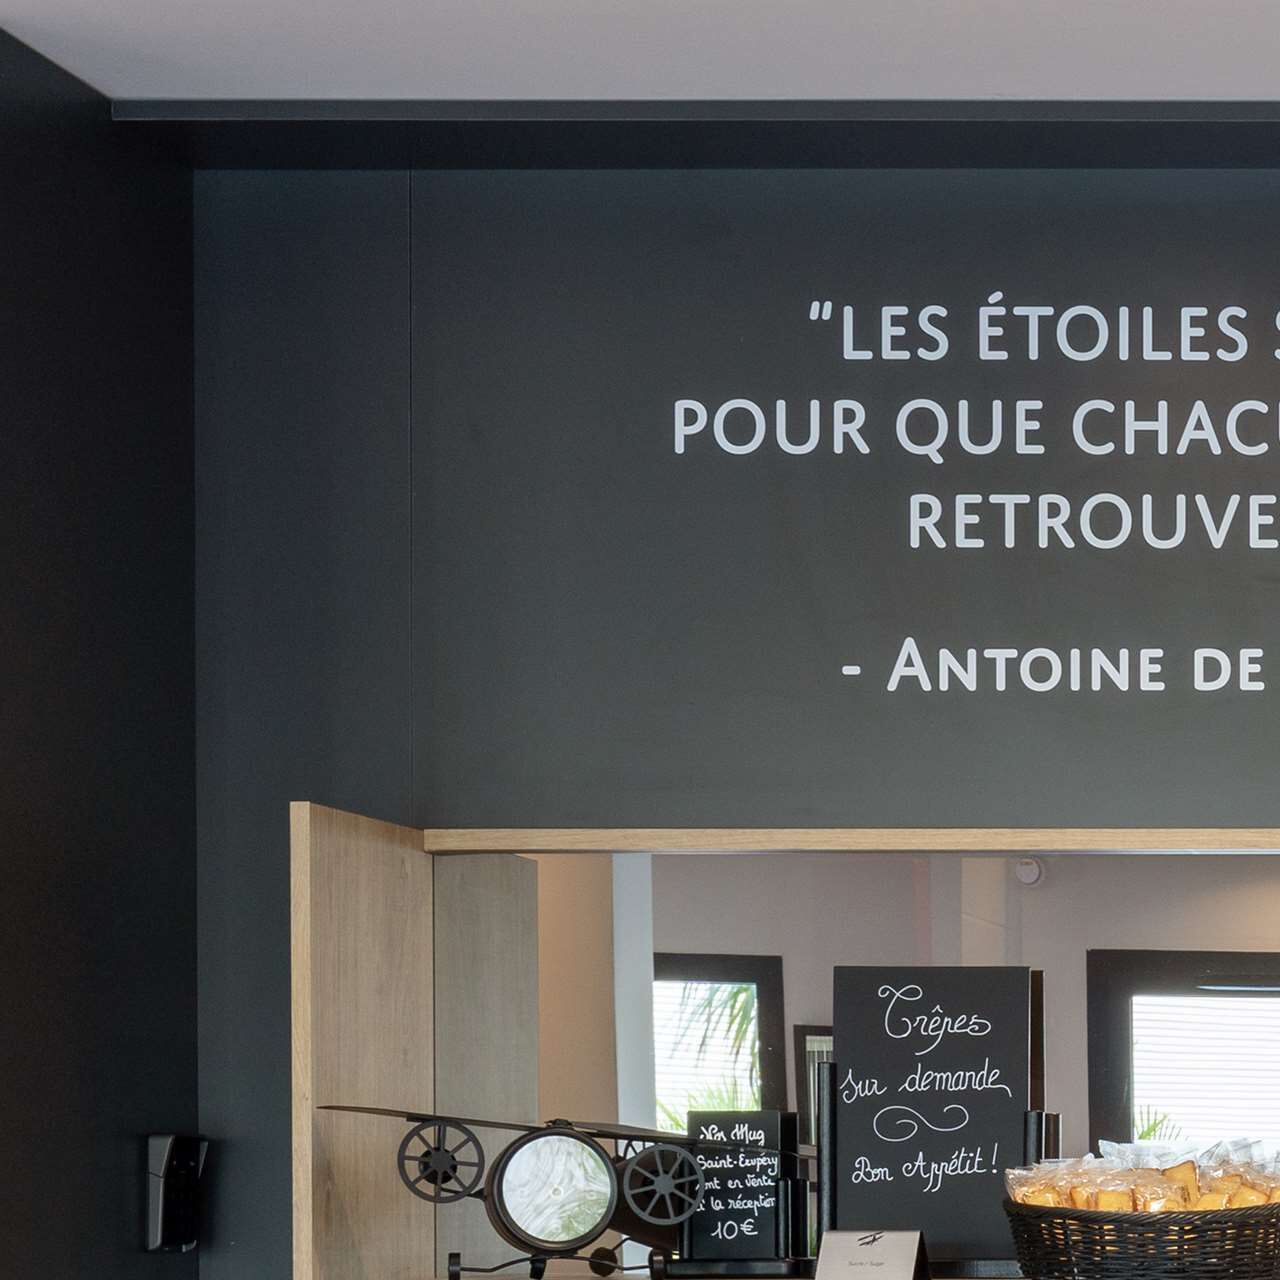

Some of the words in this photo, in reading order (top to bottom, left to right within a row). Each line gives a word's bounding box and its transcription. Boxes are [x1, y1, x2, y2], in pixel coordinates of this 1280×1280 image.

[979, 291, 1249, 362] ÉTOILES
[673, 398, 872, 456] POUR
[894, 398, 1046, 465] QUE
[877, 984, 992, 1055] Crêpes
[897, 1056, 1013, 1098] demande
[730, 1122, 766, 1147] Mug
[726, 1179, 745, 1189] en
[851, 1156, 894, 1184] Bon
[710, 1195, 726, 1212] la
